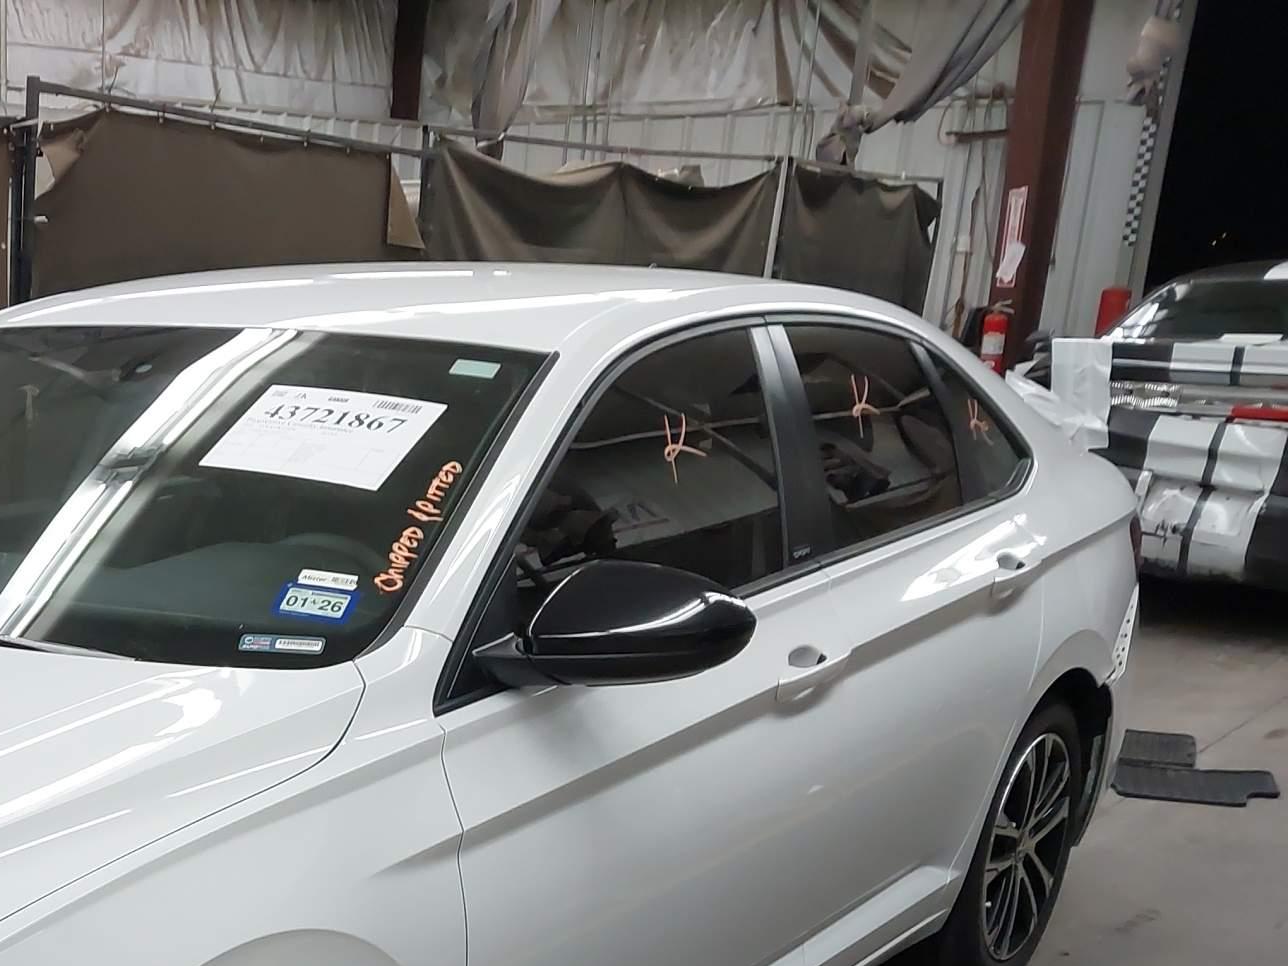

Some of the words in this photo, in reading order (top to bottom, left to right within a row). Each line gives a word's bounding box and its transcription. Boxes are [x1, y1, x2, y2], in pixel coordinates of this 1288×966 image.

[264, 403, 408, 434] 43721867
[285, 594, 309, 608] 01
[316, 599, 344, 613] 26
